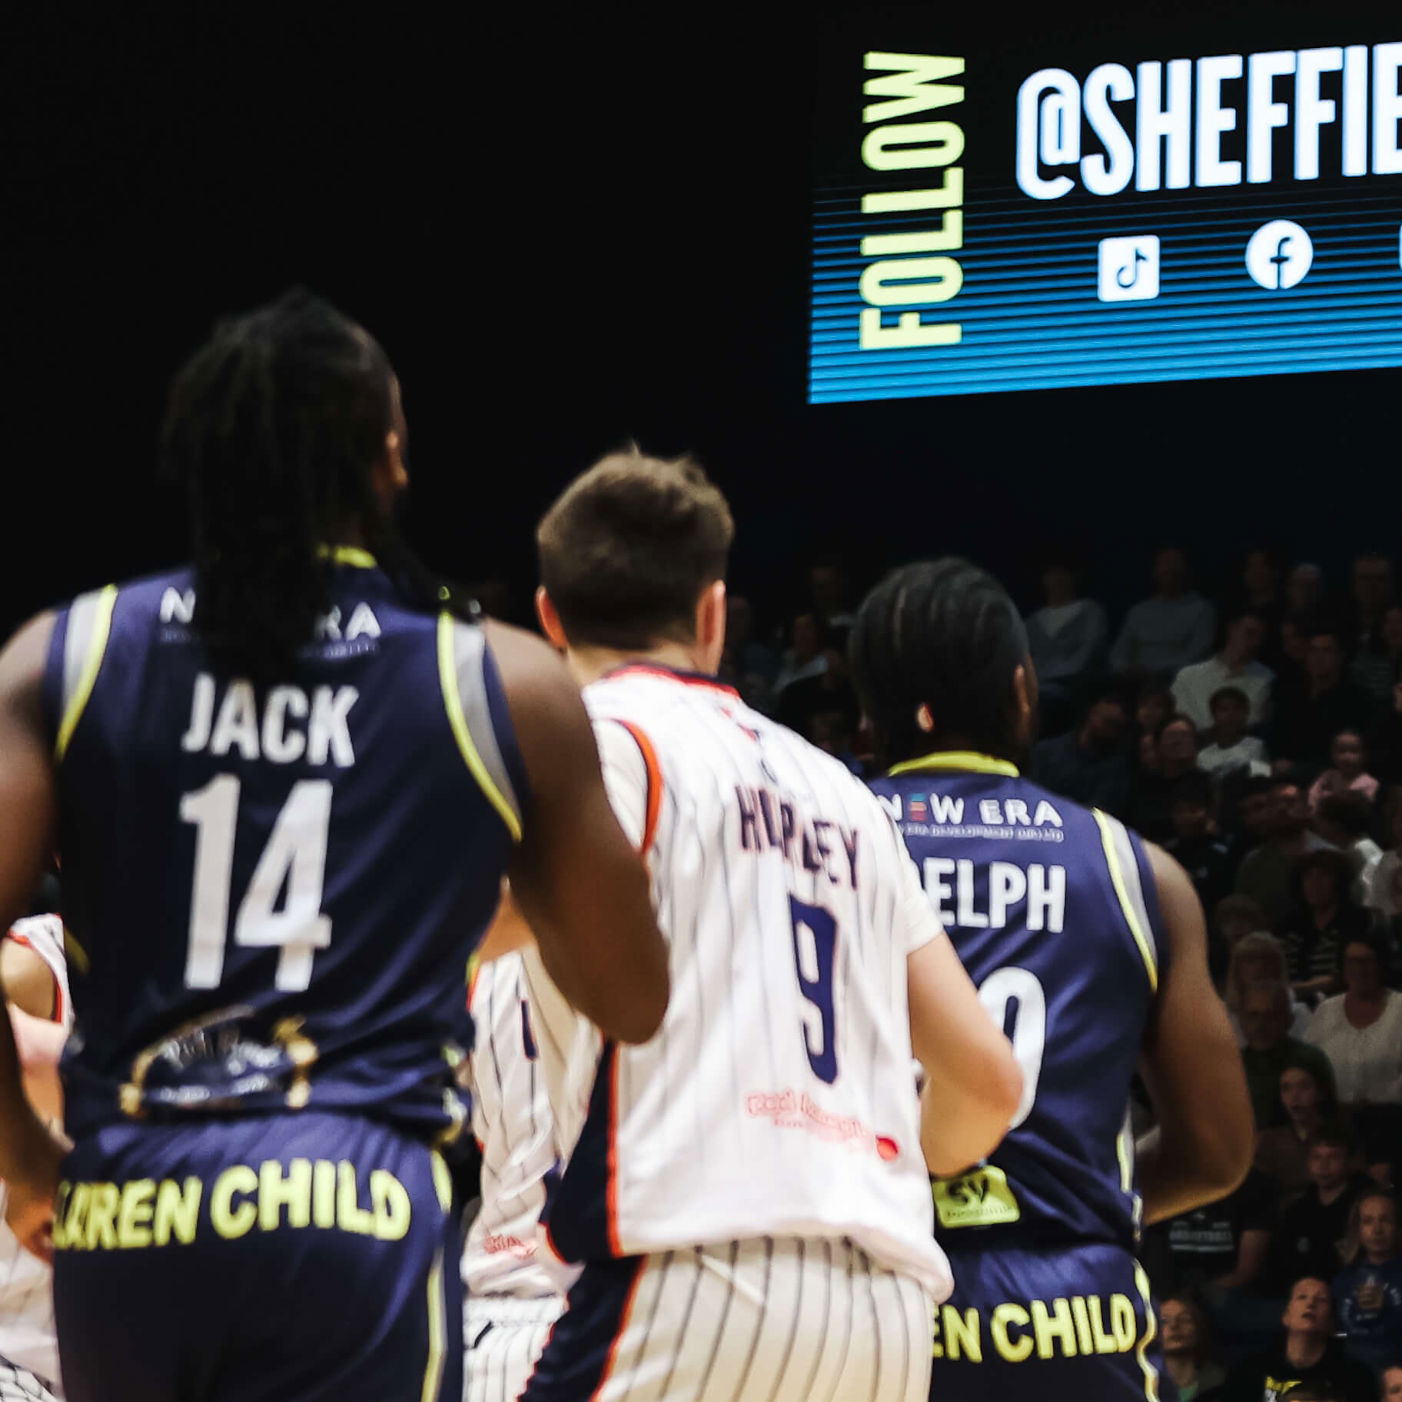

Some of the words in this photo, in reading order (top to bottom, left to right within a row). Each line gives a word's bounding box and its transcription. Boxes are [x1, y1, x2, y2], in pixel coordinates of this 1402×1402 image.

[859, 51, 965, 350] FOLLOW
[181, 671, 360, 768] JACK
[978, 798, 1064, 828] ERA
[179, 773, 333, 992] 14
[922, 857, 1067, 934] ELPH
[788, 892, 839, 1086] 9
[210, 1157, 412, 1241] CHILD
[990, 1293, 1136, 1363] CHILD
